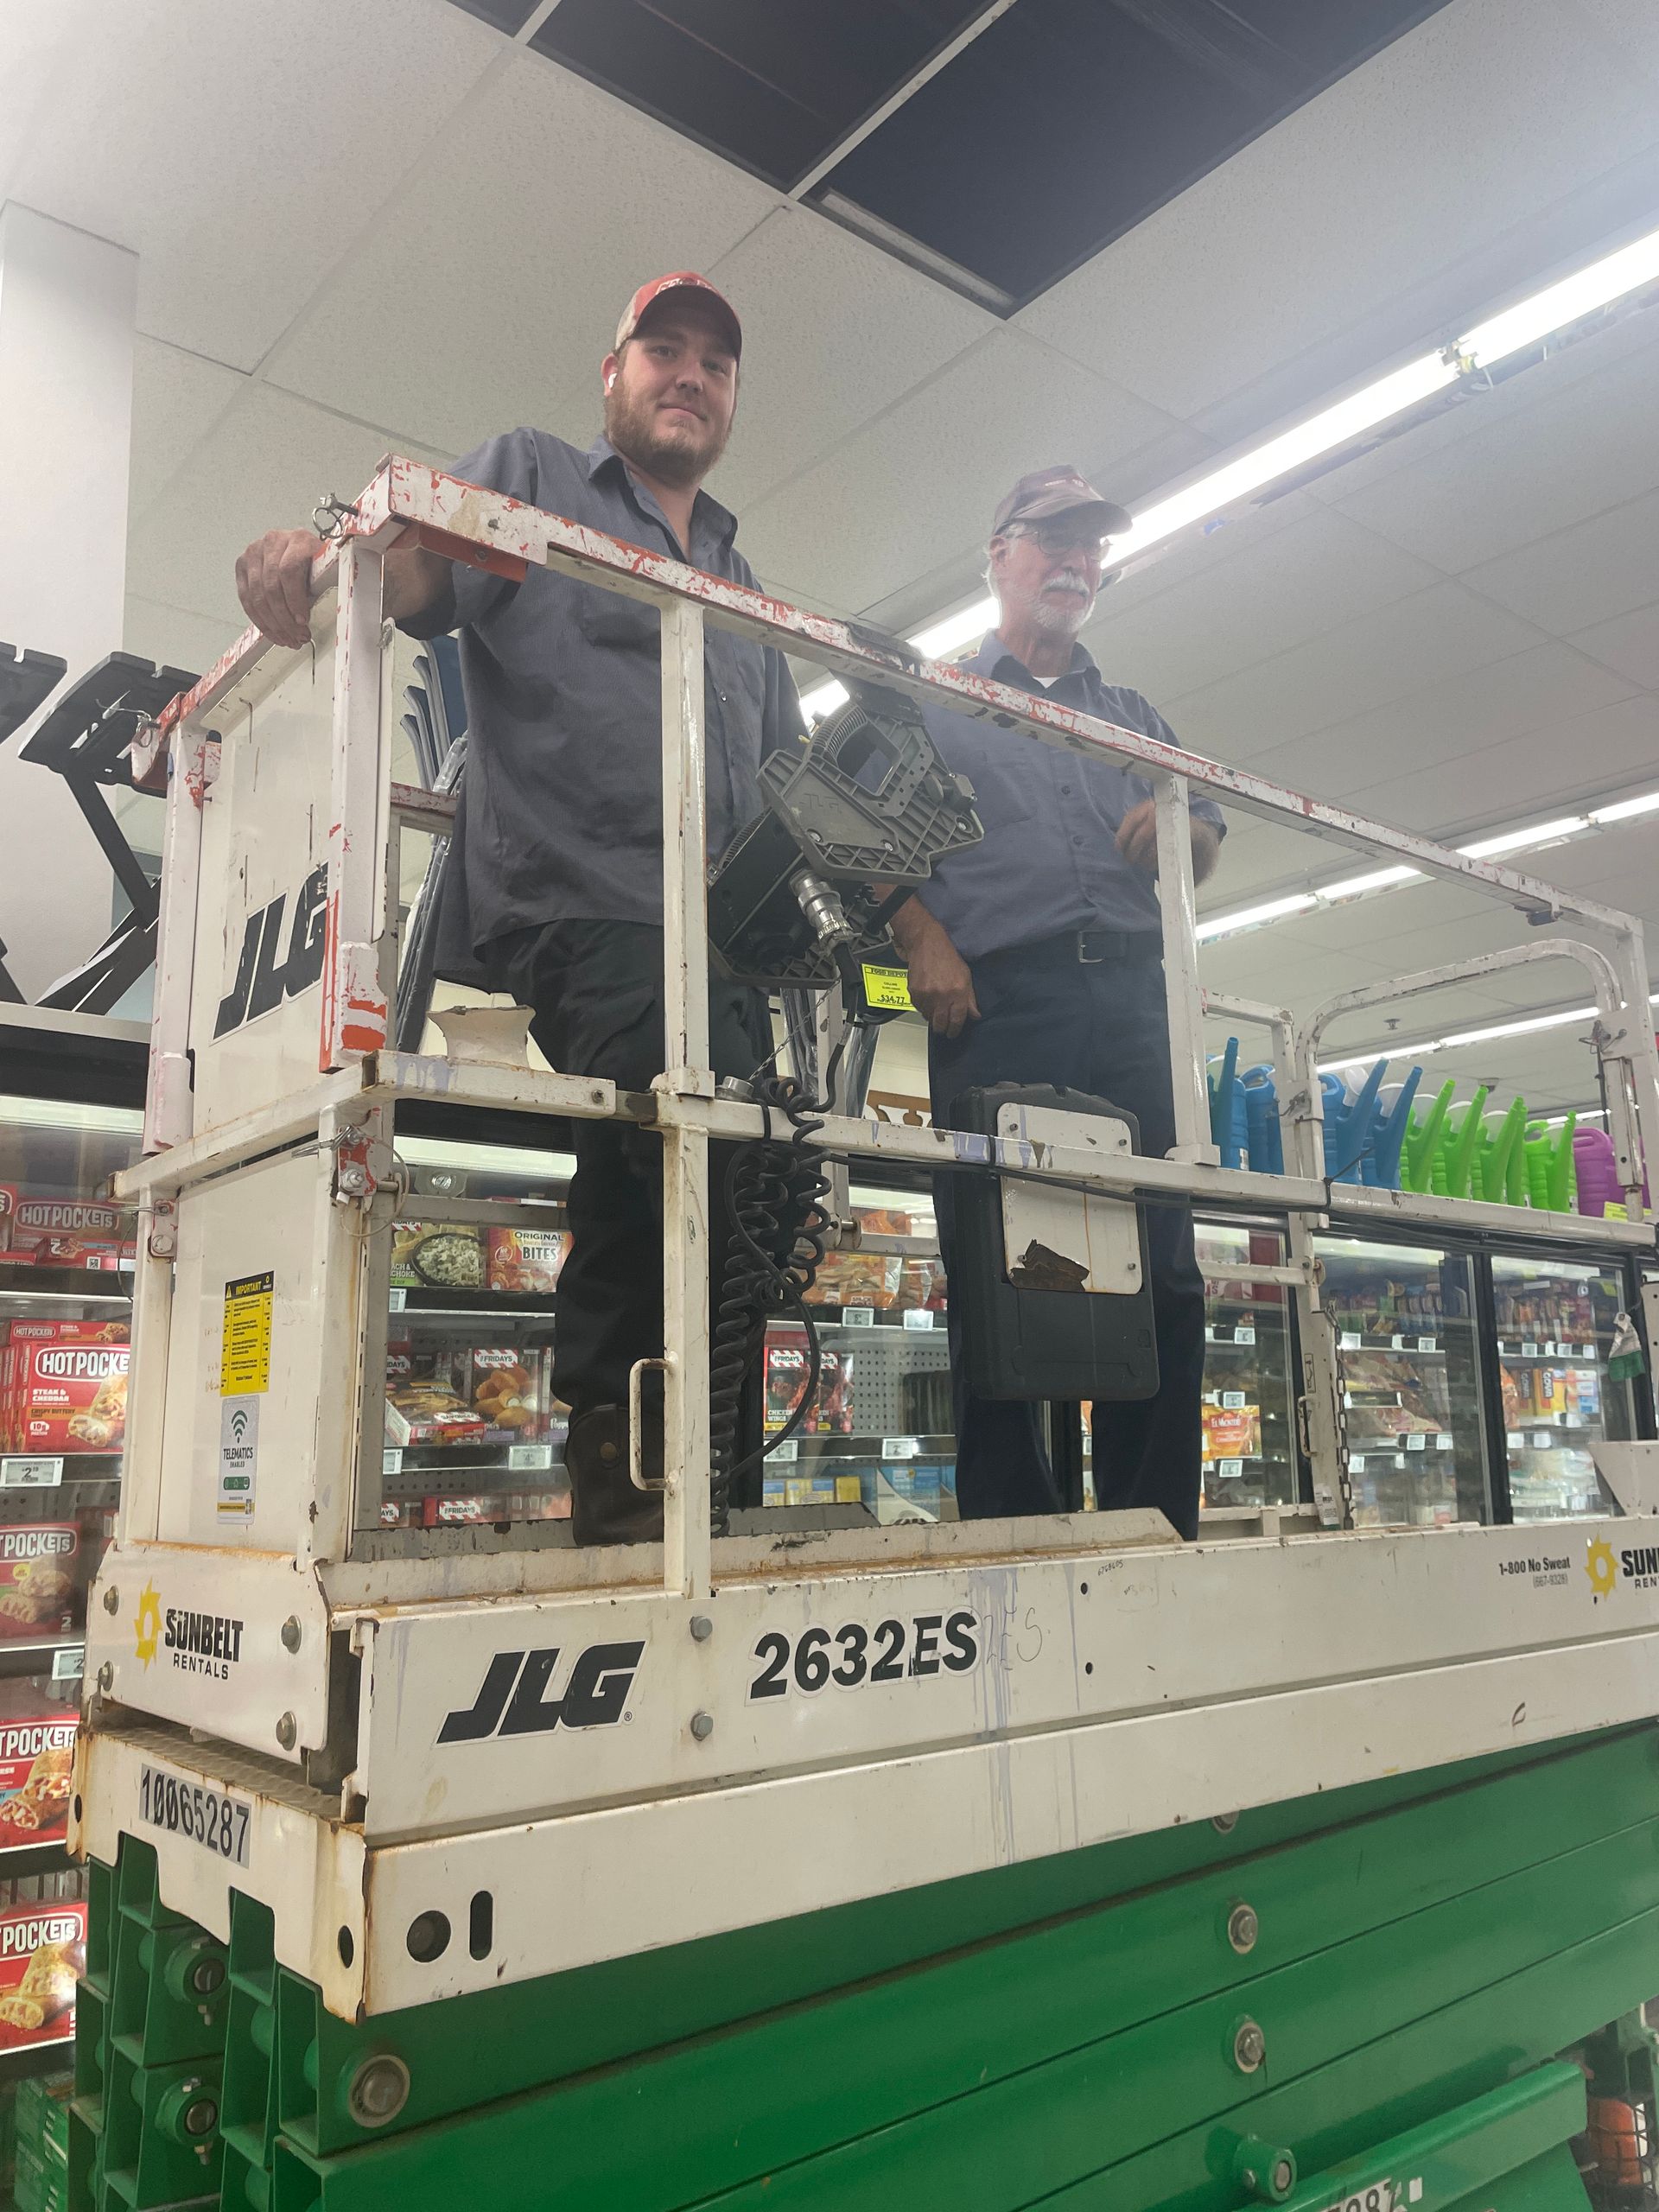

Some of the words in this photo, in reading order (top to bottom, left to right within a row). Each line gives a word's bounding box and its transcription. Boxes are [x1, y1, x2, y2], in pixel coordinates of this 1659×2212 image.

[213, 861, 328, 1040] JLG
[880, 995, 905, 1006] $34.77
[22, 1205, 51, 1225] HOT
[51, 1205, 113, 1228] POCKETS
[515, 1231, 564, 1242] ORIGINAL
[523, 1246, 557, 1261] BITES
[235, 1281, 262, 1295] IMPORTANT
[42, 1351, 75, 1376] HOT
[75, 1351, 130, 1376] POCKE
[387, 1359, 405, 1368] DAYS
[484, 1354, 512, 1363] FRIDAYS
[1542, 1372, 1553, 1397] GOYA
[223, 1447, 253, 1460] TELEMATICS
[5, 1533, 71, 1556] POCKETS
[1499, 1559, 1526, 1575] 1-800
[1529, 1558, 1541, 1572] No
[1543, 1556, 1571, 1571] Sweat
[1621, 1546, 1659, 1578] SUN
[62, 1617, 72, 1628] 2
[165, 1608, 244, 1662] SUNBELT
[173, 1652, 229, 1681] RENTALS
[750, 1611, 977, 1699] 2632ES
[436, 1640, 646, 1744] JLG
[5, 1726, 75, 1758] POCKETS
[143, 1769, 250, 1862] 10065287
[3, 1918, 76, 1955] POCKETS
